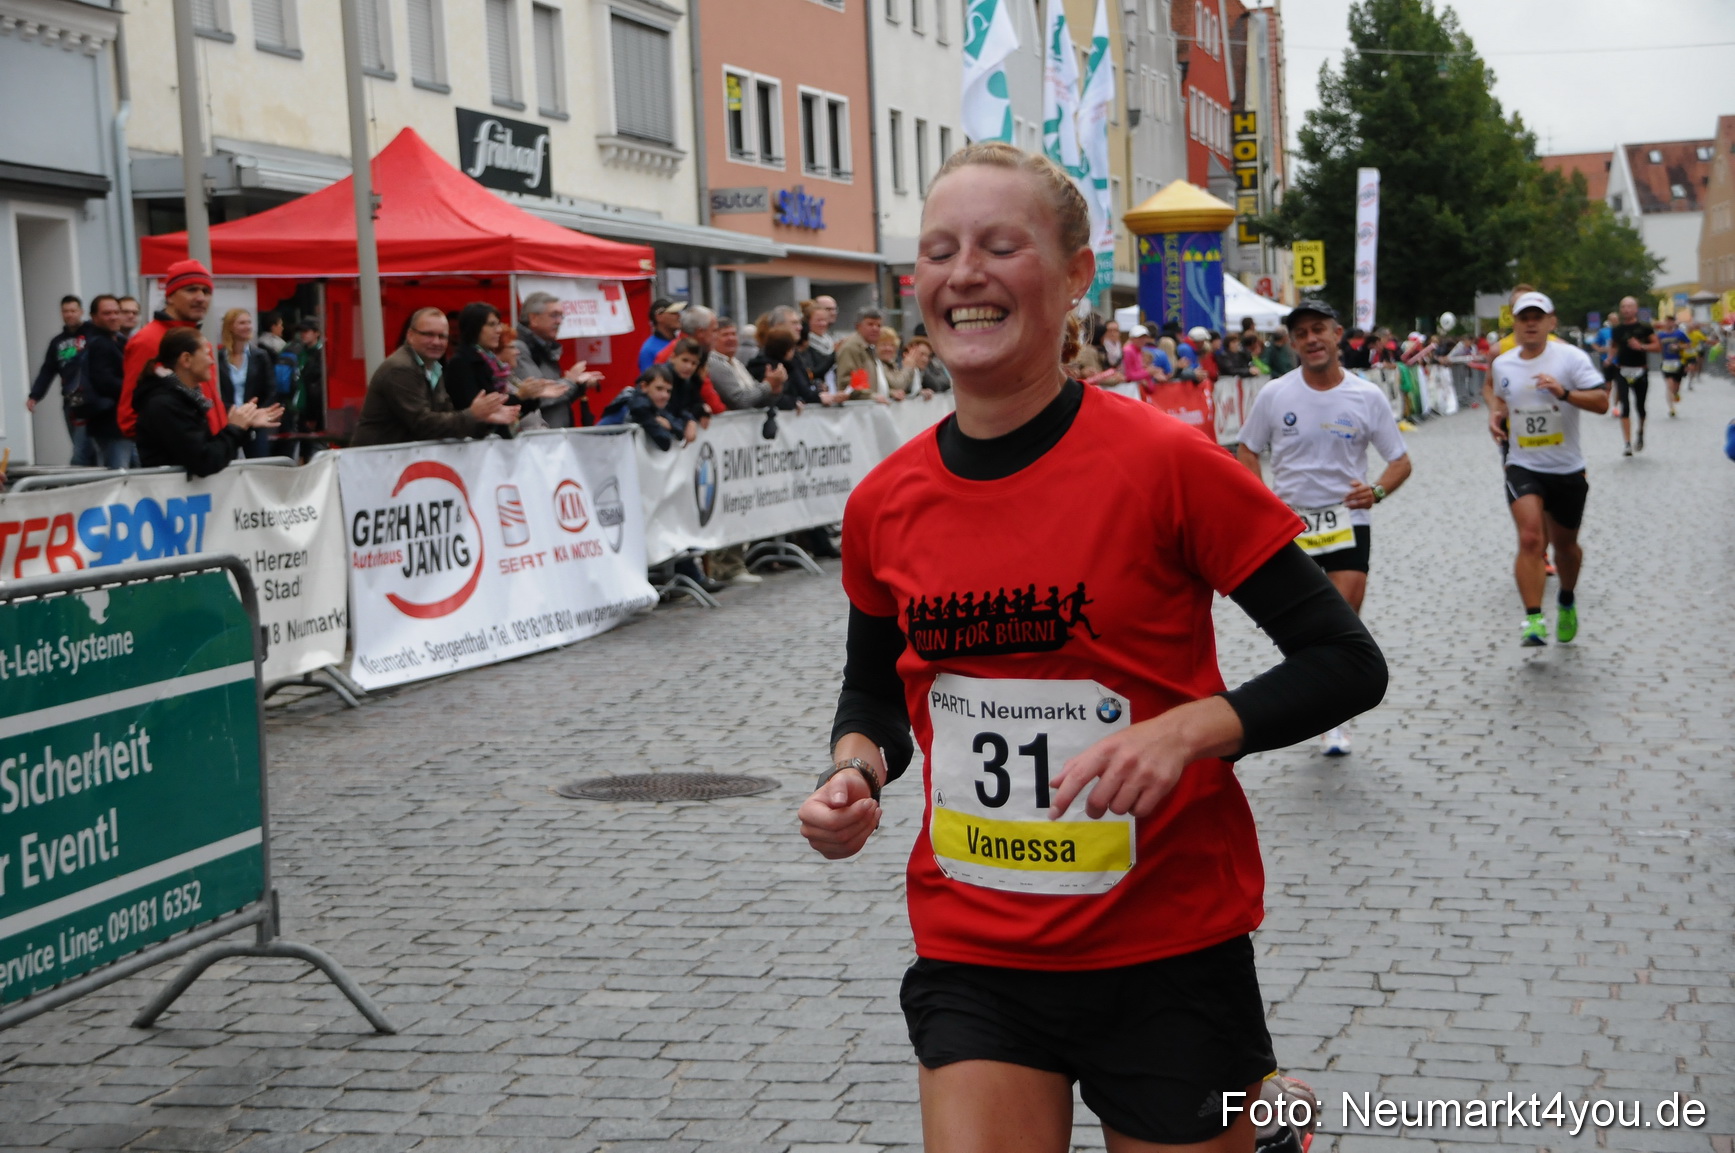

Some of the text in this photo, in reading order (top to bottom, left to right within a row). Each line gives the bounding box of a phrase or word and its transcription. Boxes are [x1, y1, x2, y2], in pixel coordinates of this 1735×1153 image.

[1232, 112, 1260, 243] HOTEL
[1301, 256, 1315, 277] B
[1525, 416, 1548, 434] 82
[233, 504, 318, 531] Kastengasse
[352, 498, 454, 547] GERHART
[558, 492, 587, 520] KIA
[255, 549, 308, 573] Herzen
[352, 549, 403, 570] Autohaus
[402, 532, 472, 579] JÄNIG
[499, 551, 547, 575] SEAT
[264, 575, 304, 601] Stad
[914, 617, 1057, 651] RUN FOR BÜRNI
[359, 644, 422, 675] Neumarkt
[424, 628, 489, 664] Sengenthal
[931, 691, 1086, 721] PARTL Neumarkt
[0, 723, 153, 814] Sicherheit
[972, 731, 1051, 809] 31
[20, 807, 120, 889] Event!
[966, 824, 1076, 863] Vanessa
[59, 923, 104, 964] Line:
[106, 895, 158, 944] 09181
[162, 880, 202, 922] 6352
